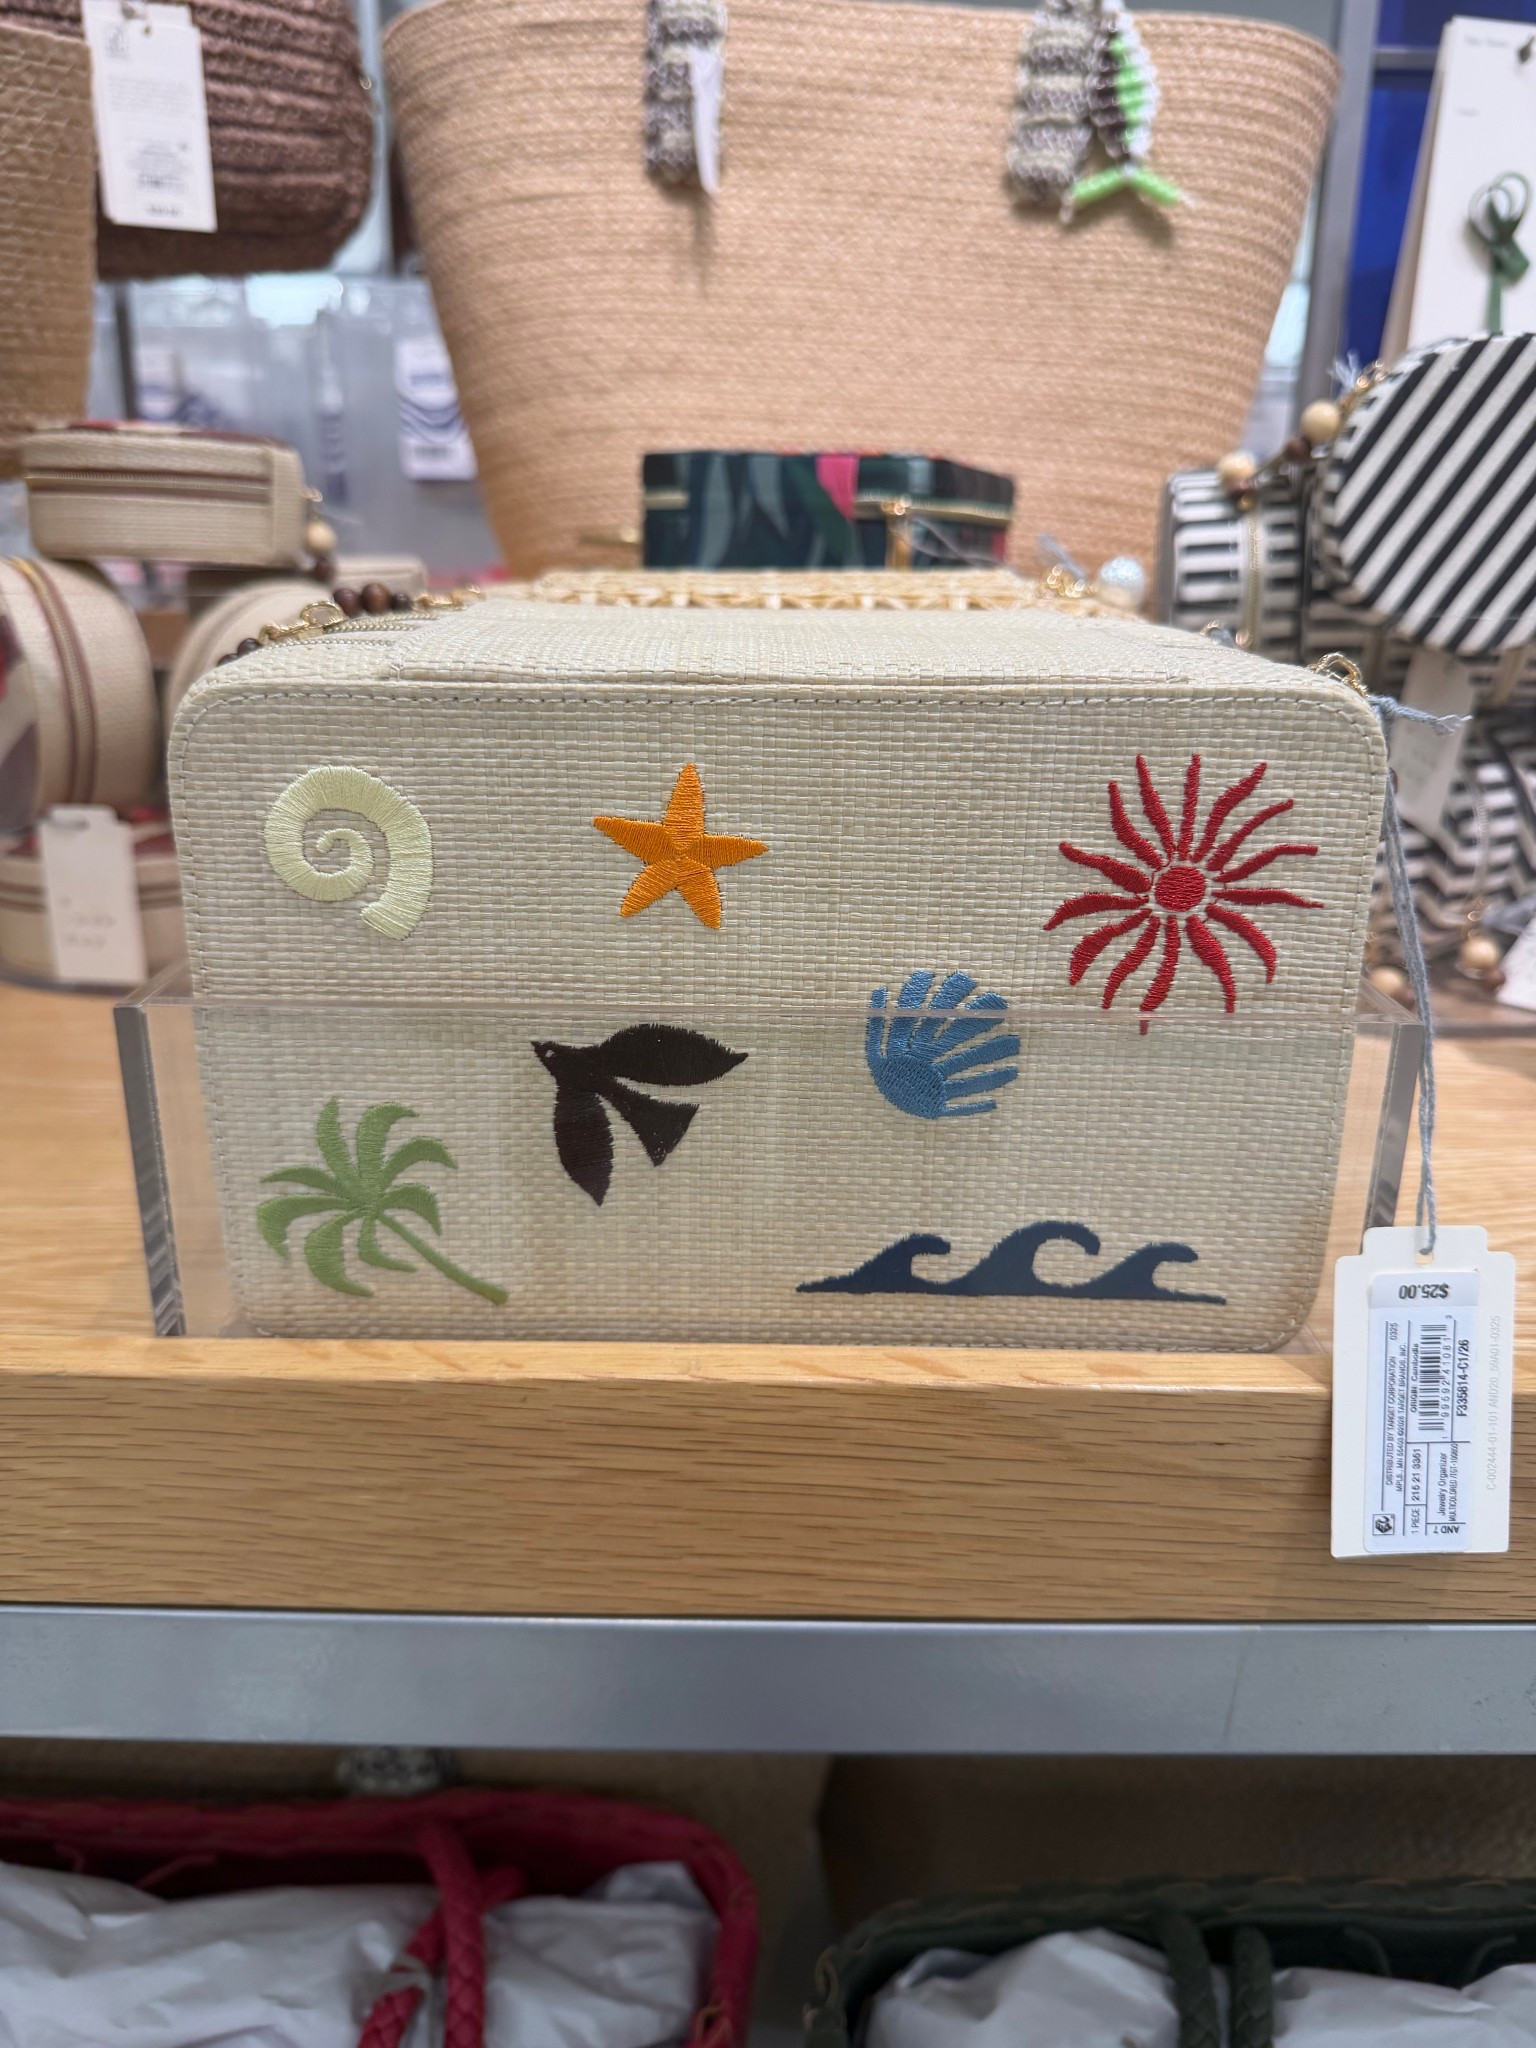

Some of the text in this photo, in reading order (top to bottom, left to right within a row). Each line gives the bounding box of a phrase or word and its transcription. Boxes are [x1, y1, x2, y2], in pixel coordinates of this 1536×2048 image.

[1399, 1283, 1449, 1299] $25.00
[1388, 1356, 1396, 1404] CORPORATION
[1456, 1339, 1469, 1417] F335814-C1/26
[1397, 1389, 1405, 1413] TARGET
[1387, 1433, 1394, 1441] BY
[1396, 1458, 1403, 1468] MN
[1412, 1473, 1420, 1483] 21
[1438, 1452, 1448, 1516] Jewelry Organizer
[1448, 1480, 1457, 1521] MULTICOLORED
[1441, 1525, 1459, 1533] AND
